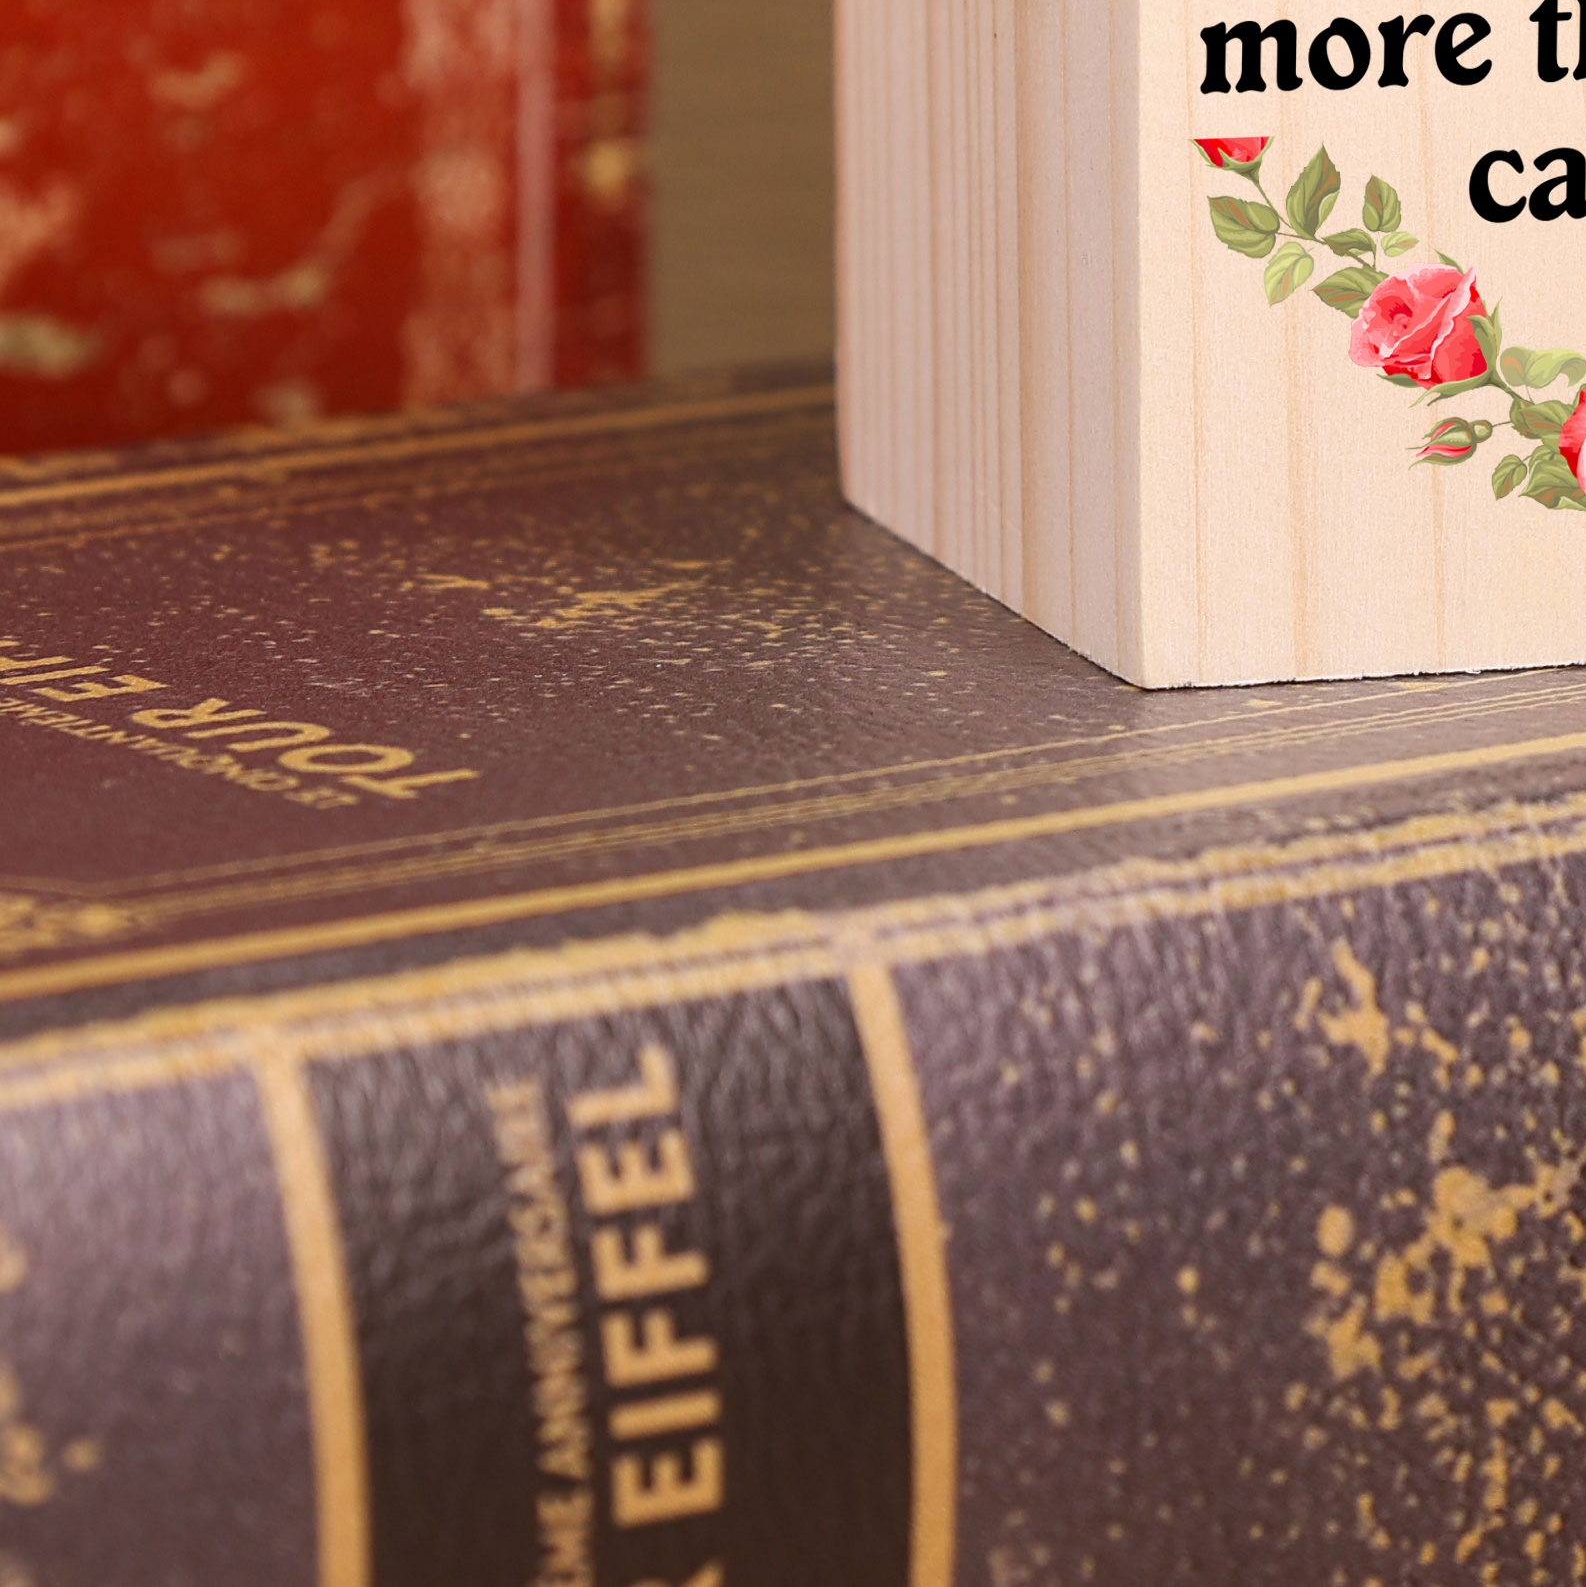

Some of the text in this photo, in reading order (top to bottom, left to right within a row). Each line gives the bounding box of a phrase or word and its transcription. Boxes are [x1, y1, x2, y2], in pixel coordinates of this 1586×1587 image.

[1199, 12, 1494, 96] more
[0, 640, 481, 800] TOUR EIF
[565, 1042, 725, 1529] EIFFEL
